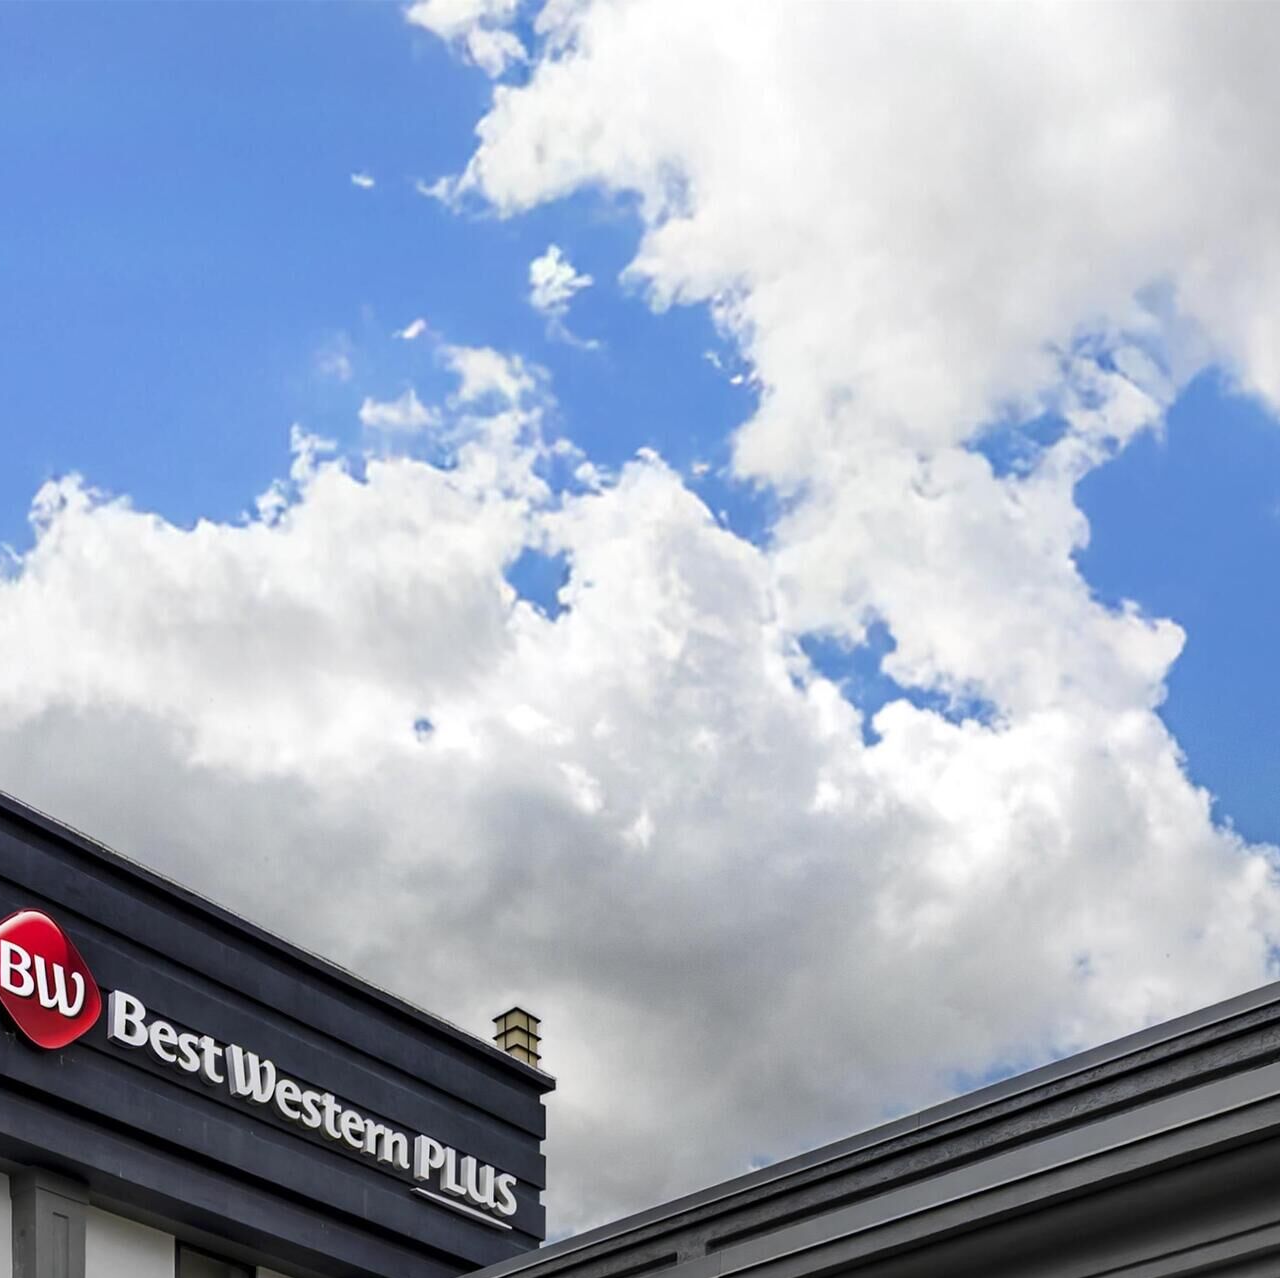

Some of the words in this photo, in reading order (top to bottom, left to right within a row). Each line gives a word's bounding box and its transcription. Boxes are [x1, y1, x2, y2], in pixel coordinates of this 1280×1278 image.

[0, 938, 86, 1018] BW
[107, 989, 225, 1085] Best
[225, 1043, 410, 1170] Western
[414, 1134, 518, 1218] PLUS
